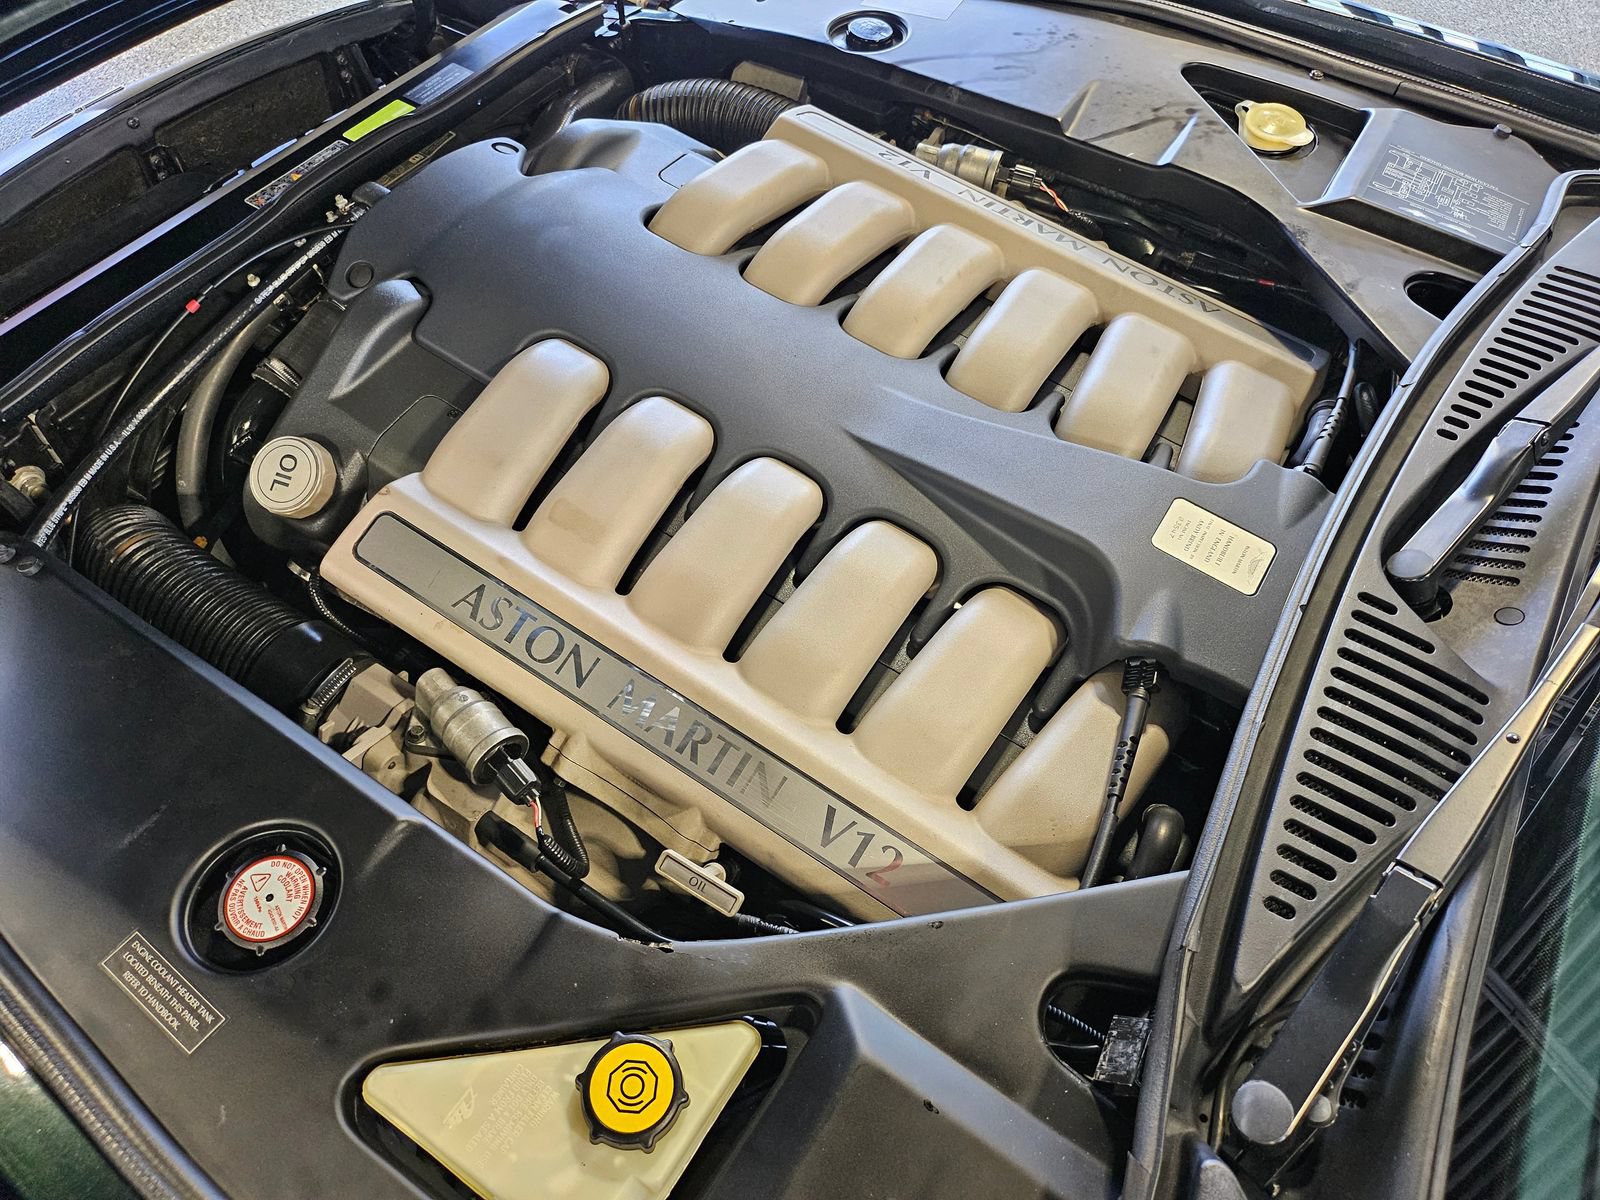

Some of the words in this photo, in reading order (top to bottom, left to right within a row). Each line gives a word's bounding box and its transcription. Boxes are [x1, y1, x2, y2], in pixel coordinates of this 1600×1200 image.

[876, 146, 929, 180] V12
[956, 187, 1088, 251] MARTIN
[1100, 255, 1221, 316] ASTON
[86, 457, 105, 476] MADE
[98, 451, 110, 462] IN
[269, 451, 299, 496] OIL
[1191, 517, 1205, 535] ANDY
[1217, 527, 1226, 536] IN
[1202, 536, 1221, 564] ENGLAND
[1213, 534, 1235, 567] HANDBUILT
[449, 581, 602, 691] ASTON
[605, 676, 789, 811] MARTIN
[824, 803, 906, 889] V12
[282, 861, 295, 870] NOT
[295, 868, 307, 883] OPEN
[229, 889, 238, 901] PAS
[235, 878, 244, 888] NE
[277, 874, 293, 902] COOLANT
[285, 871, 300, 899] WARNING
[300, 883, 309, 904] WHEN
[688, 875, 707, 893] OIL
[228, 902, 240, 926] OUVRIR
[235, 885, 262, 929] AVERTISSEMENT
[292, 905, 303, 919] HOT
[242, 927, 265, 937] CHAUD
[121, 969, 141, 990] REFER
[121, 950, 150, 978] LOCATED
[144, 973, 173, 1001] BENEATH
[167, 996, 185, 1013] THIS
[178, 1008, 203, 1032] PANEL.
[130, 939, 155, 963] ENGINE
[148, 958, 180, 988] COOLANT
[173, 983, 201, 1009] HEADER
[194, 1004, 216, 1024] TANK
[136, 984, 149, 998] TO
[142, 992, 183, 1031] HANDBOOK.
[485, 1061, 526, 1107] CONTAINER
[509, 1067, 533, 1093] FLUID
[492, 1089, 516, 1115] FROM
[506, 1093, 524, 1112] DOT
[516, 1078, 547, 1112] BEFORE
[528, 1083, 554, 1113] CLEAN
[486, 1111, 498, 1123] A
[508, 1108, 536, 1138] FILLER
[527, 1090, 561, 1129] WARNING
[461, 1119, 493, 1153] SEALED
[486, 1108, 525, 1153] REMOVING
